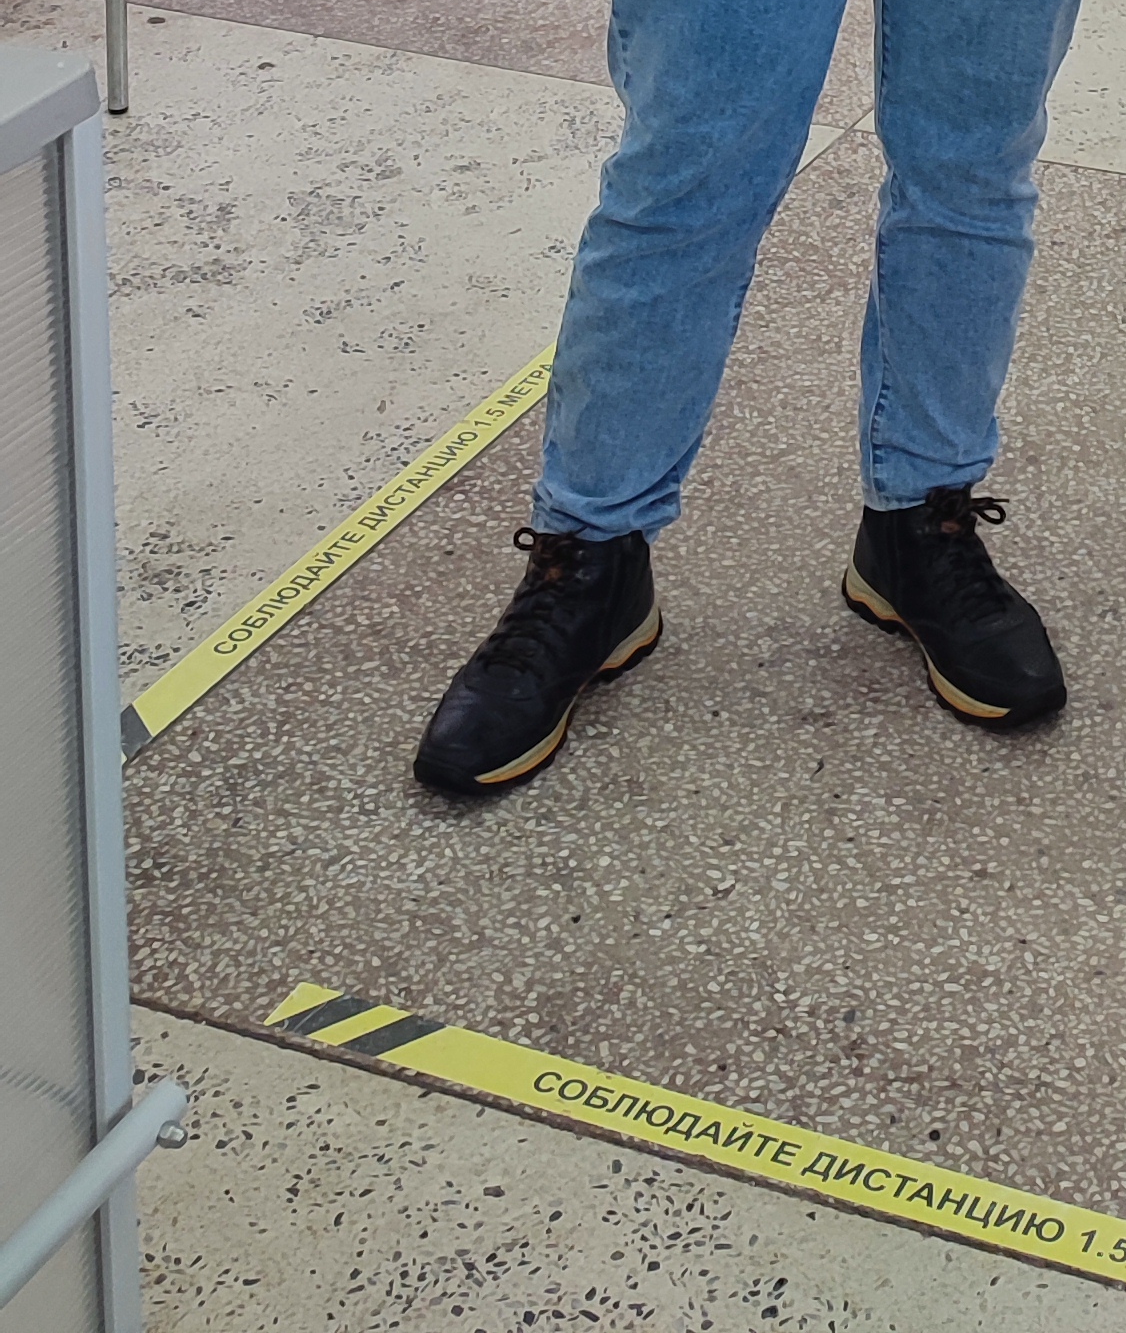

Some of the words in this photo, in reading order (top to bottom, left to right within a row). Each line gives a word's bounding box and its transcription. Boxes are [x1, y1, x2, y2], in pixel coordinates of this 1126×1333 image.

[213, 531, 366, 655] СОБЛЮДАЙТЕ
[357, 431, 479, 531] ДИСТАНЦИЮ
[474, 408, 506, 427] 1.5
[497, 364, 553, 407] МЕТРА
[533, 1071, 803, 1167] СОБЛЮДАЙТЕ
[800, 1151, 1066, 1243] ДИСТАНЦИЮ
